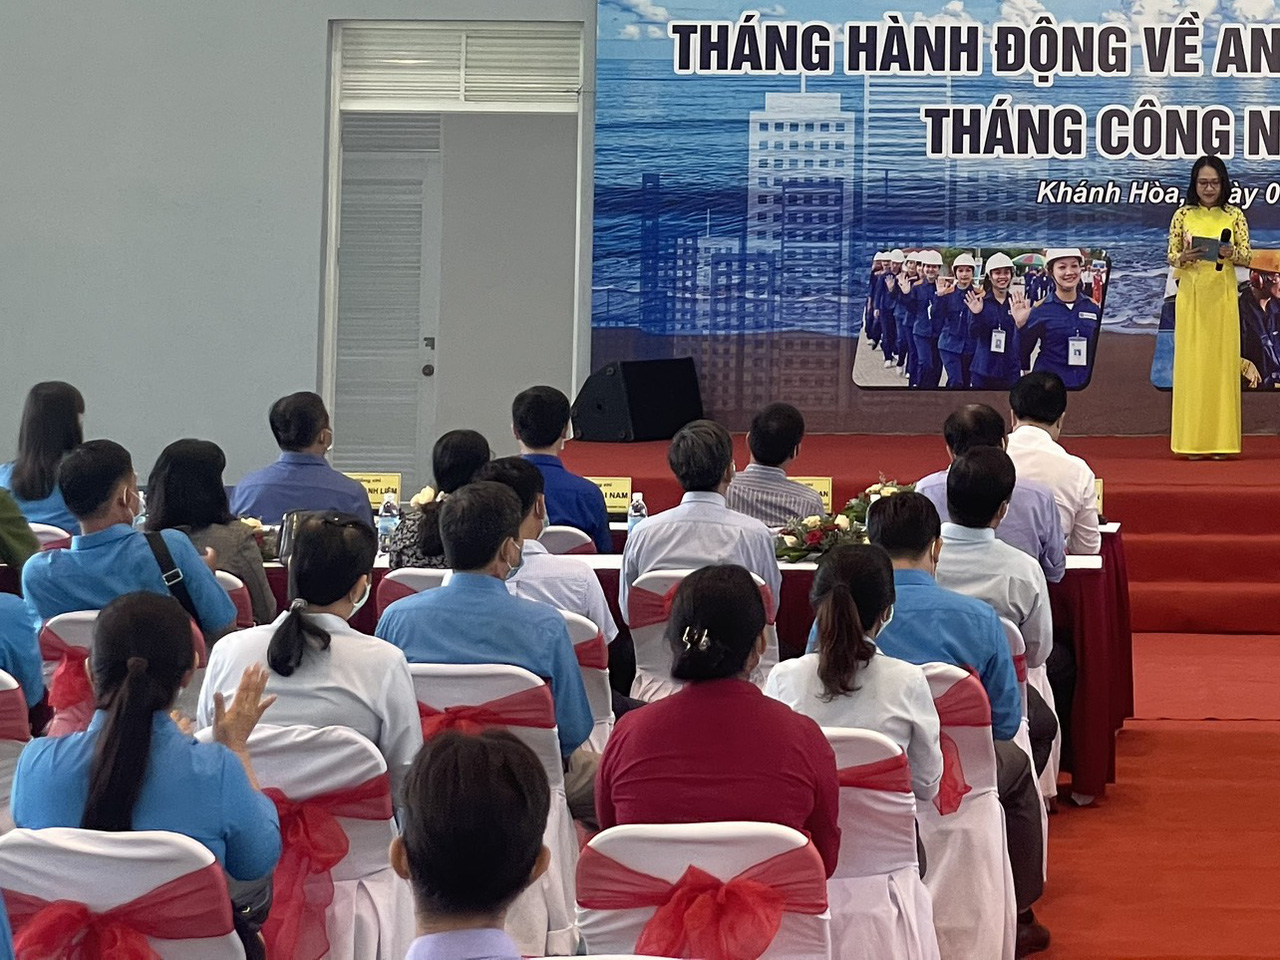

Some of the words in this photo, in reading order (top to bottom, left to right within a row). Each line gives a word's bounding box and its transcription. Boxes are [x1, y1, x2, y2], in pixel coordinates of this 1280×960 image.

[671, 14, 832, 72] THÁNG
[847, 14, 980, 72] HÀNH
[994, 16, 1128, 83] ĐỘNG
[1143, 11, 1200, 74] VỀ
[924, 98, 1083, 155] THÁNG
[1099, 98, 1231, 156] CÔNG
[1036, 181, 1121, 204] Khánh
[1127, 181, 1187, 208] Hòa,
[609, 491, 628, 499] NAM
